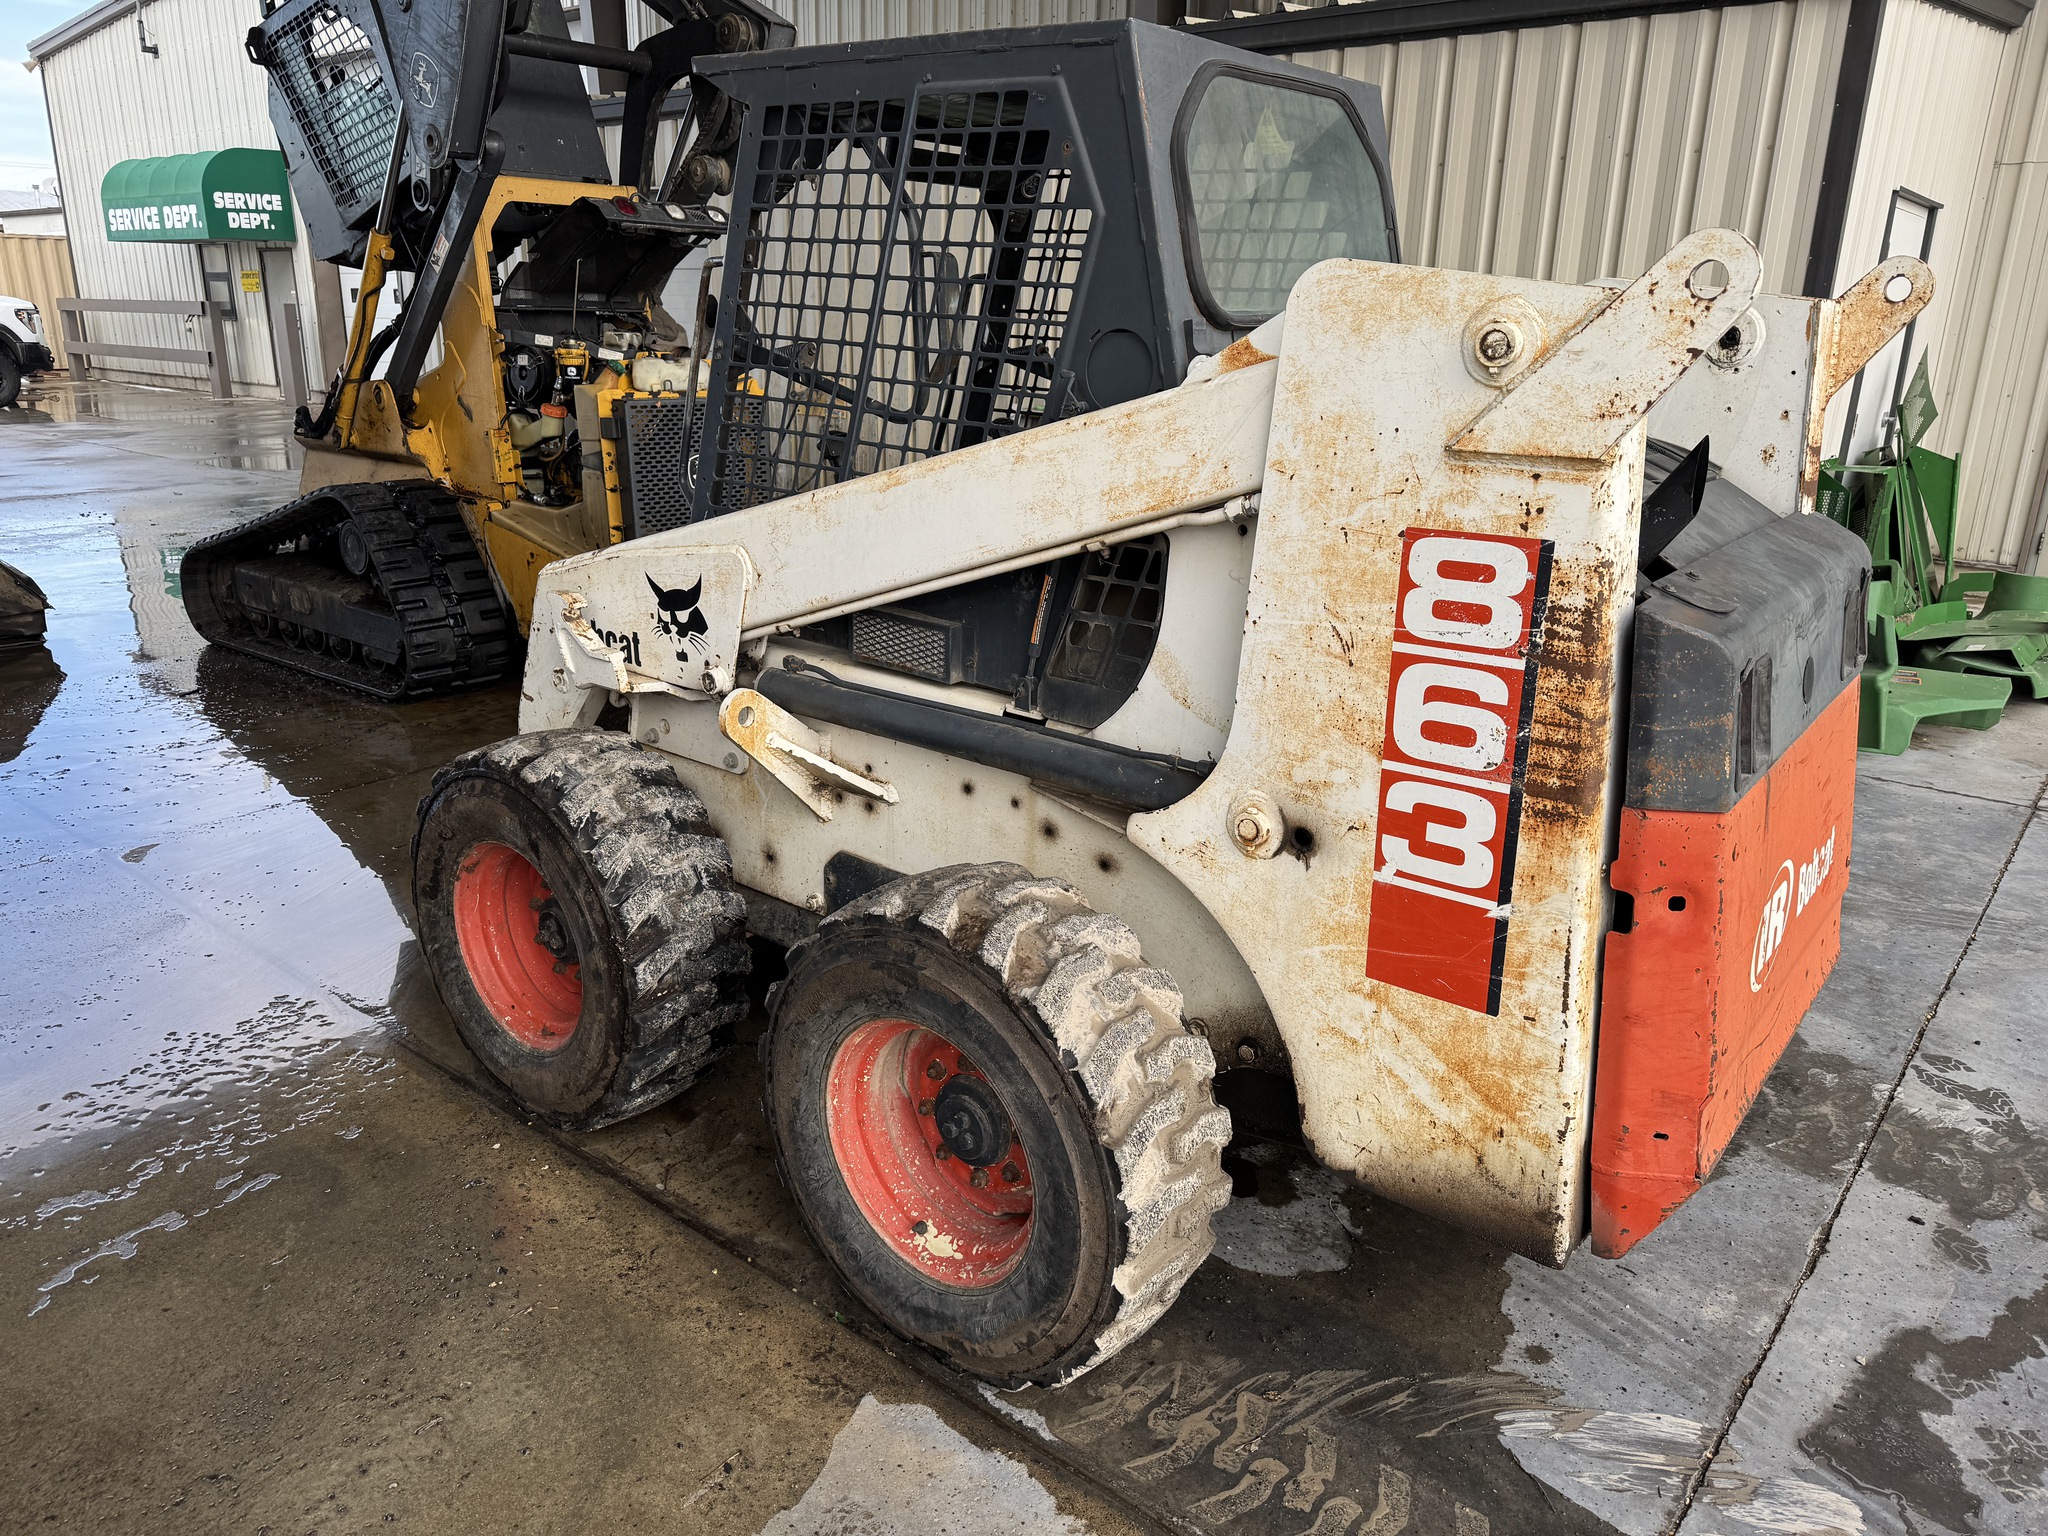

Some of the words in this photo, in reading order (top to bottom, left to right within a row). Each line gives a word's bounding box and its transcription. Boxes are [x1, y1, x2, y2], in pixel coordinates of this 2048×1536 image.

[213, 191, 282, 211] SERVICE
[108, 206, 160, 231] SERVICE
[163, 204, 203, 230] DEPT.
[227, 212, 276, 230] DEPT.
[1796, 825, 1836, 918] Bobcat
